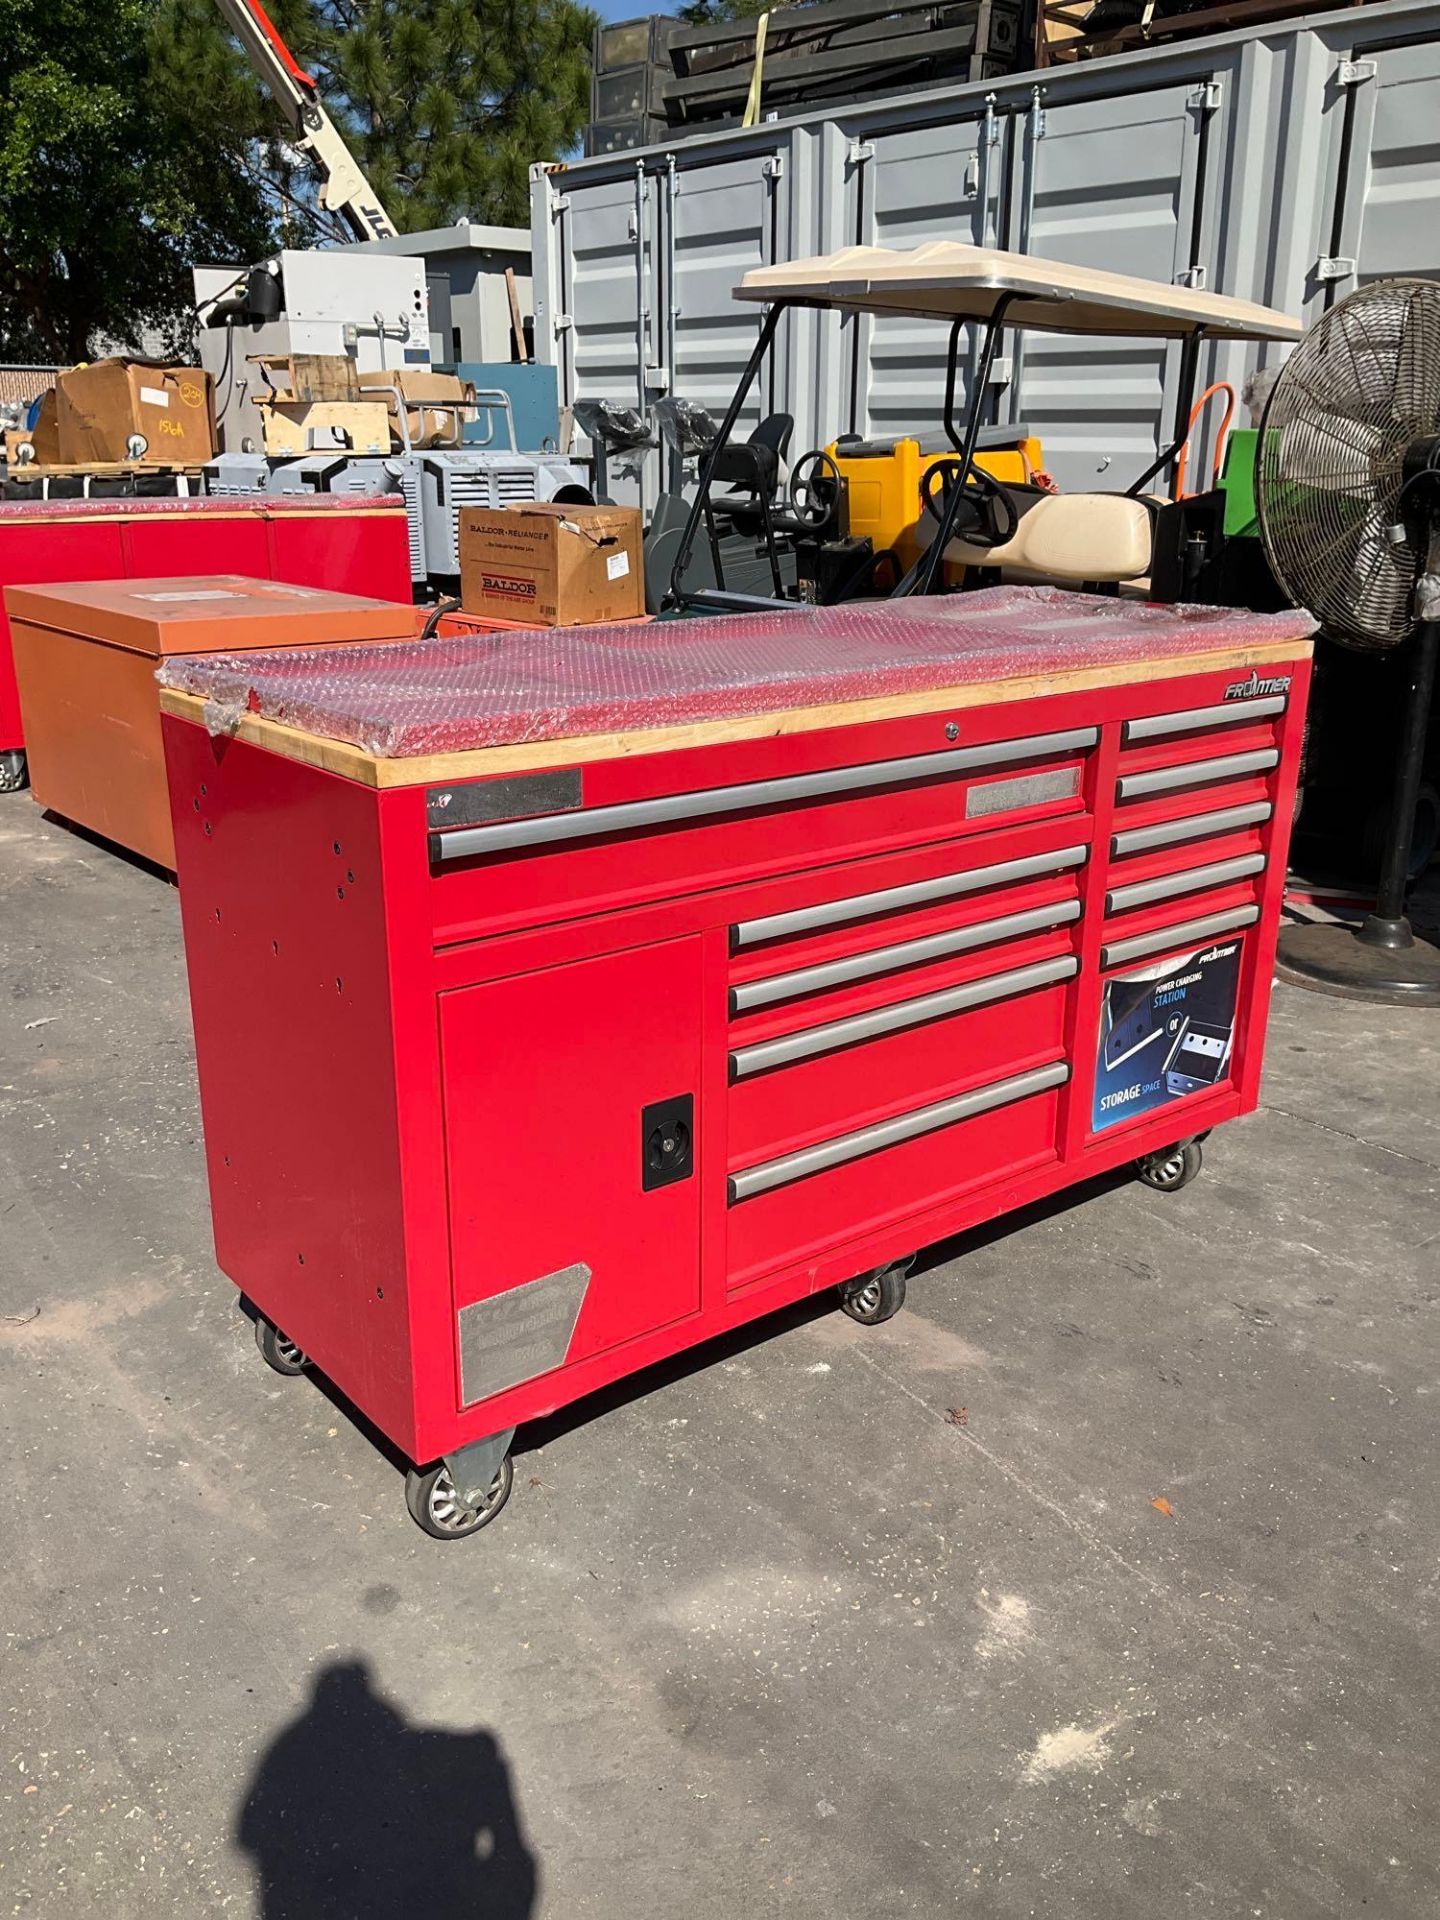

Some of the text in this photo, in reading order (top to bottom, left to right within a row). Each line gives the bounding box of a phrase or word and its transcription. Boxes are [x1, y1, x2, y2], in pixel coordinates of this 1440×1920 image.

[482, 578, 536, 595] BALDOR
[1224, 669, 1292, 699] FRONTIER
[1155, 971, 1202, 994] POWER CHARGING
[1153, 988, 1186, 1008] STATION
[1100, 1080, 1161, 1111] STORAGE SPACE
